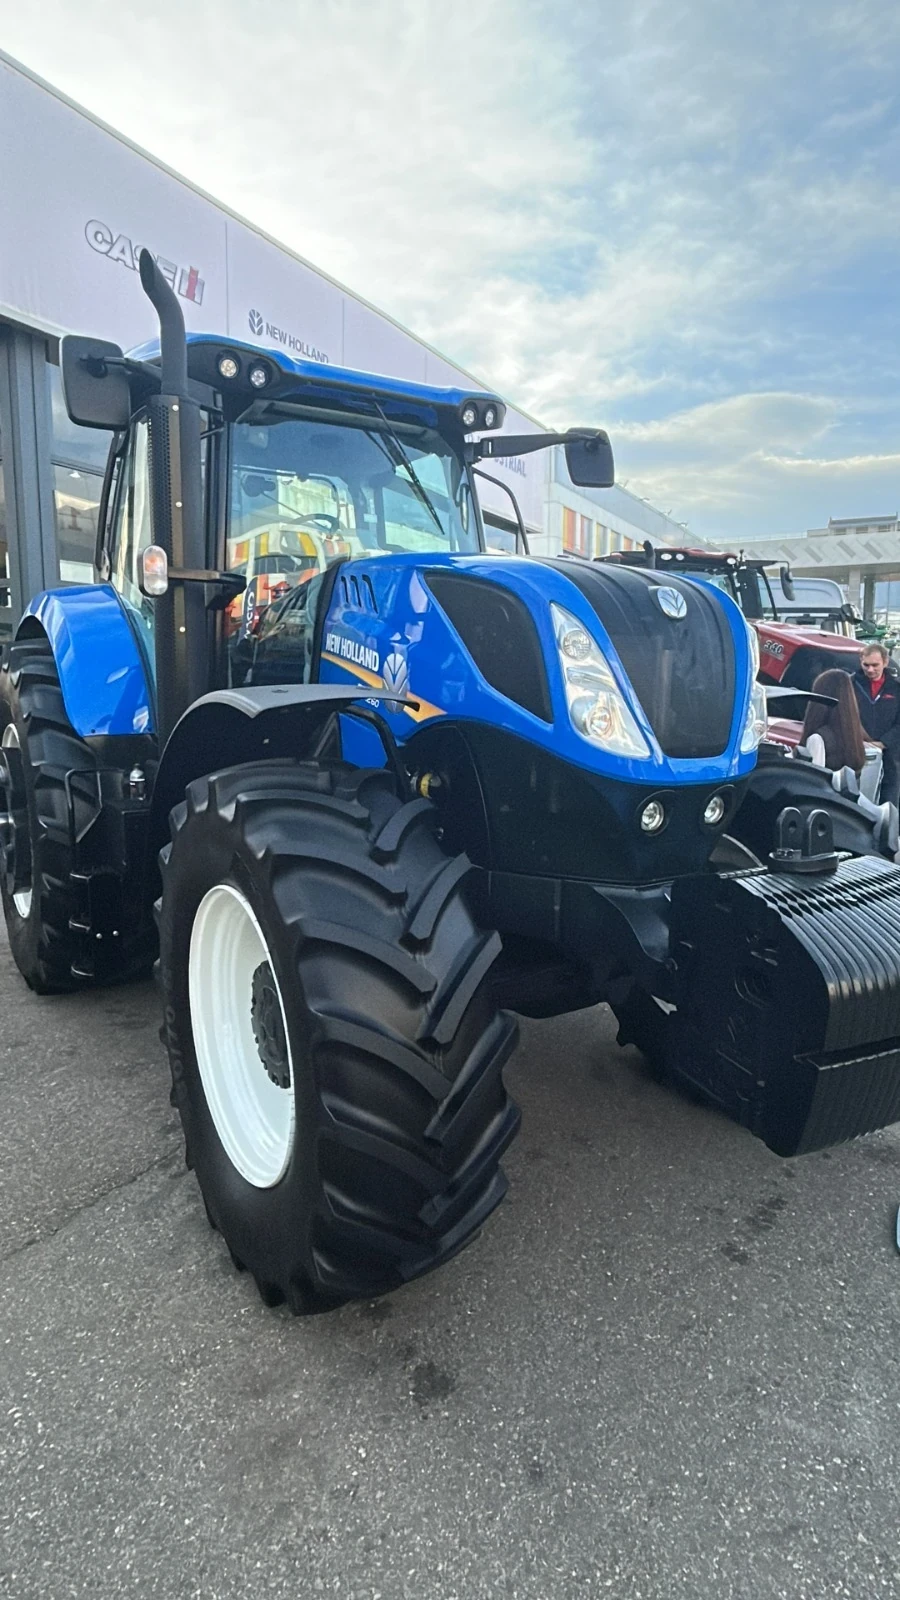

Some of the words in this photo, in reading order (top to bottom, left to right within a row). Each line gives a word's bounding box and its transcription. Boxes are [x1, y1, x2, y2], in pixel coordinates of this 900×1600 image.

[265, 321, 288, 345] NEW
[289, 331, 330, 364] HOLLAND
[325, 632, 341, 655] NEW
[340, 638, 380, 672] HOLLAND
[764, 639, 784, 655] 340
